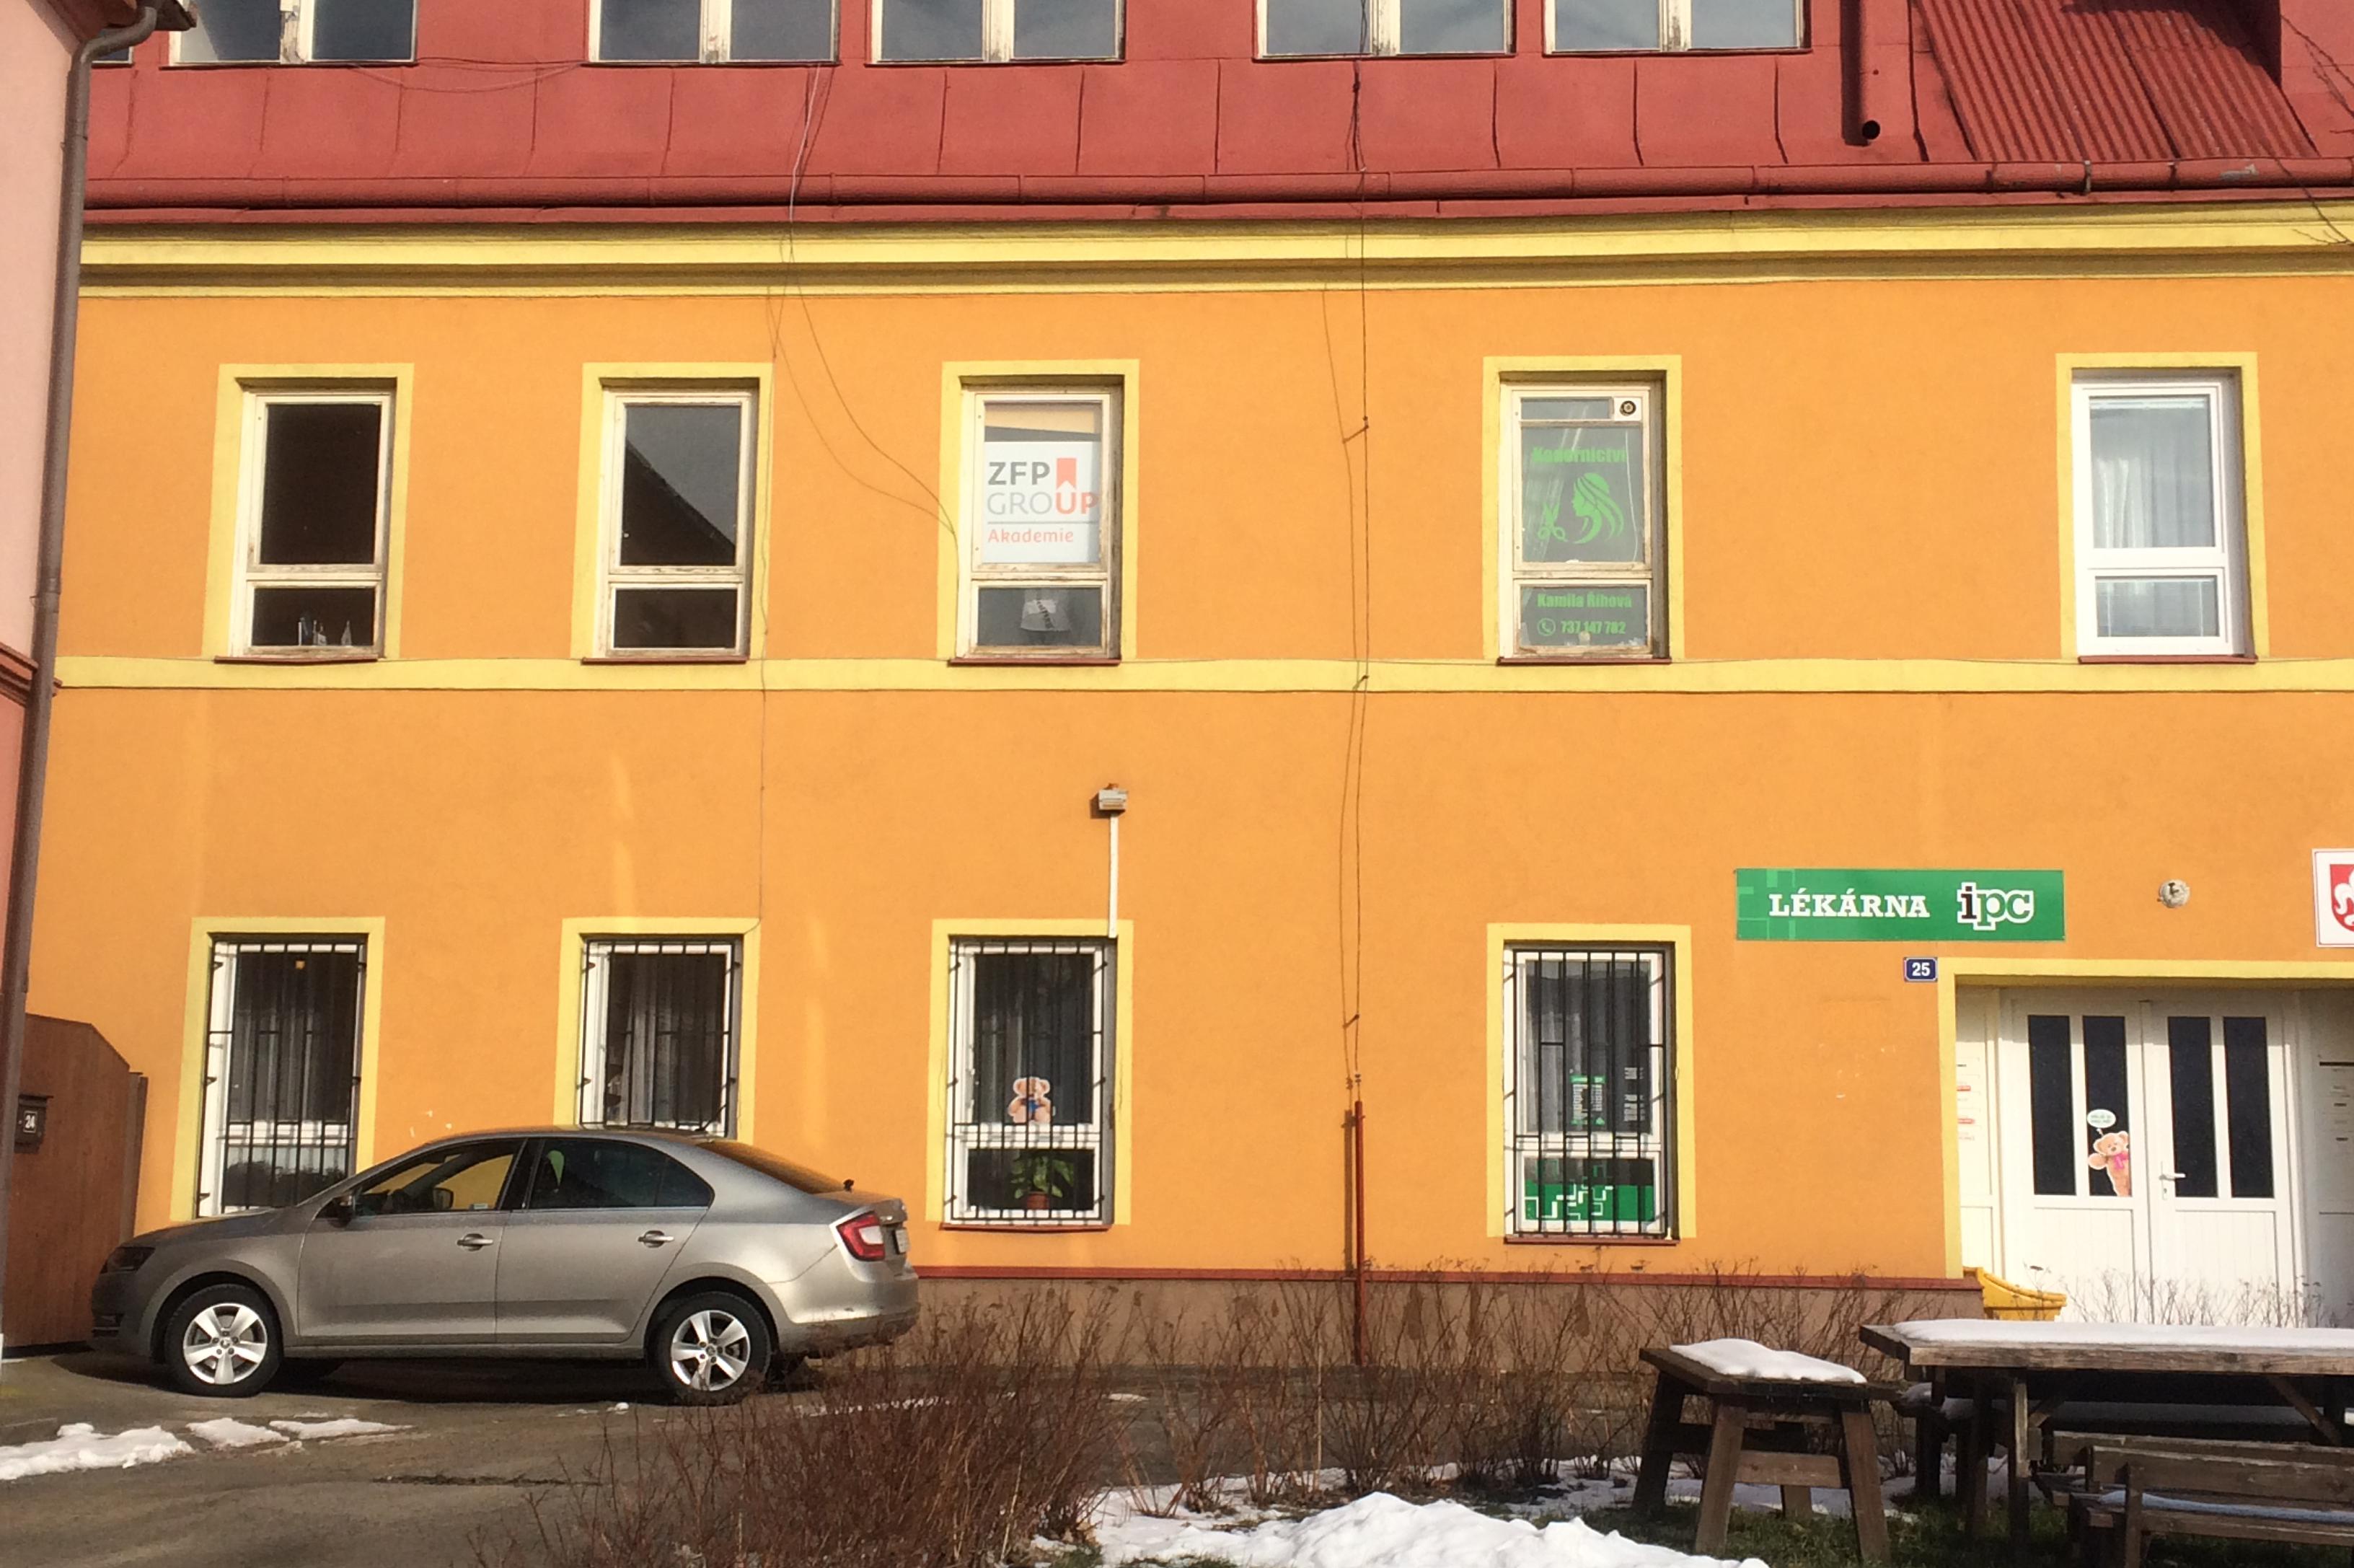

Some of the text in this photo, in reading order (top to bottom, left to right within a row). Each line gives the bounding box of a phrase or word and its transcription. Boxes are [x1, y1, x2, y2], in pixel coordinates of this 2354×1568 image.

[988, 462, 1050, 485] ZFP
[987, 492, 1099, 515] GROUP
[987, 528, 1074, 542] Akademie
[1538, 594, 1584, 607] Kamila
[1561, 621, 1581, 634] 737
[1584, 621, 1603, 634] 147
[1768, 884, 2032, 928] LÉKÁRNA ipc
[1912, 962, 1931, 977] 25
[25, 1114, 35, 1129] 24
